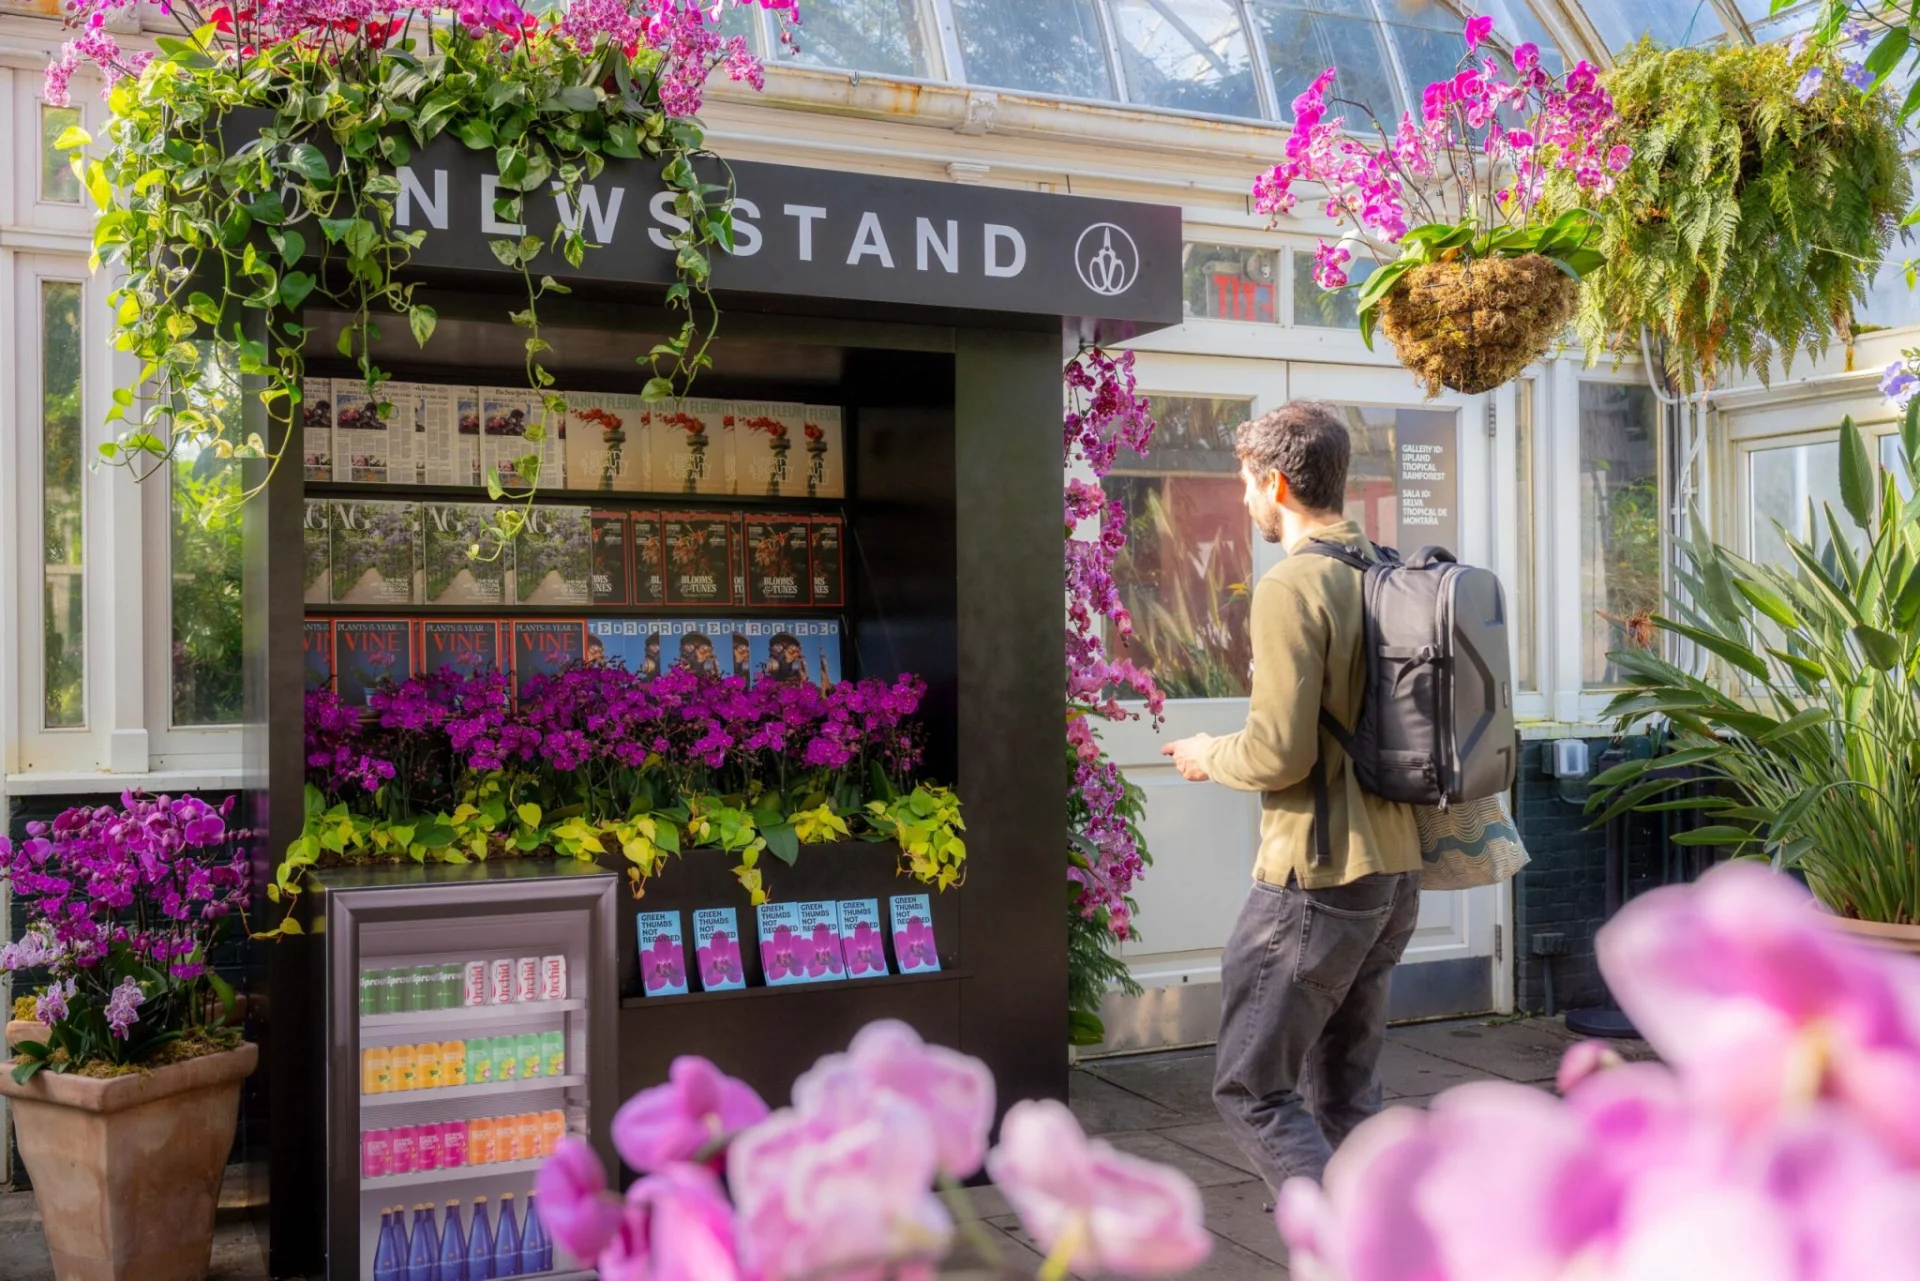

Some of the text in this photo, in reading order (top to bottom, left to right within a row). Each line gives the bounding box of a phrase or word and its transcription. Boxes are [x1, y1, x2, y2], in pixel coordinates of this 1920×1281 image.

[395, 165, 1028, 279] NEWSSTAND
[568, 395, 604, 408] VANITY
[606, 396, 638, 410] FLEUR
[736, 403, 770, 416] VANITY
[772, 405, 804, 417] FLEUR
[809, 408, 840, 421] FLEUR
[1402, 444, 1433, 454] GALLERY
[1402, 454, 1431, 462] UPLAND
[1402, 463, 1436, 472] TROPICAL
[1402, 472, 1445, 481] RAINFOREST
[1402, 489, 1421, 498] SALA
[1402, 499, 1424, 507] SELVA
[1402, 508, 1448, 517] TROPICAL DE
[681, 575, 713, 585] BLOOMS
[763, 576, 794, 585] BLOOMS
[337, 623, 368, 631] PLANTS
[377, 623, 397, 631] YEAR
[426, 624, 456, 632] PLANTS
[464, 624, 485, 632] YEAR
[516, 624, 545, 632] PLANTS
[552, 624, 572, 632] YEAR
[588, 622, 622, 635] TED
[624, 622, 659, 635] ROO
[660, 622, 731, 636] ROOTED
[750, 622, 818, 636] ROOTED
[345, 631, 402, 652] VINE
[433, 632, 489, 653] VINE
[523, 632, 577, 652] VINE
[761, 905, 784, 913] GREEN
[800, 903, 823, 911] GREEN
[843, 901, 865, 909] GREEN
[895, 903, 923, 911] THUMBS
[698, 910, 722, 918] GREEN
[761, 912, 791, 920] THUMBS
[801, 910, 830, 918] THUMBS
[843, 907, 871, 916] THUMBS
[896, 910, 911, 918] NOT
[641, 913, 666, 921] GREEN
[699, 917, 729, 925] THUMBS
[802, 917, 816, 925] NOT
[897, 917, 930, 925] REQUIRED
[642, 920, 673, 929] THUMBS
[762, 919, 777, 927] NOT
[802, 923, 837, 932] REQUIRED
[845, 922, 878, 930] REQUIRED
[642, 928, 658, 936] NOT
[699, 925, 715, 933] NOT
[763, 925, 799, 934] REQUIRED
[643, 934, 680, 943] REQUIRED
[700, 931, 736, 940] REQUIRED
[387, 975, 412, 987] Sprou
[413, 973, 438, 985] Sprou
[439, 971, 464, 983] Sprou
[524, 961, 536, 1001] Orchid
[548, 960, 560, 999] Orchid
[361, 977, 387, 989] Sprou
[472, 966, 484, 1005] Orchid
[498, 963, 510, 1003] Orchid
